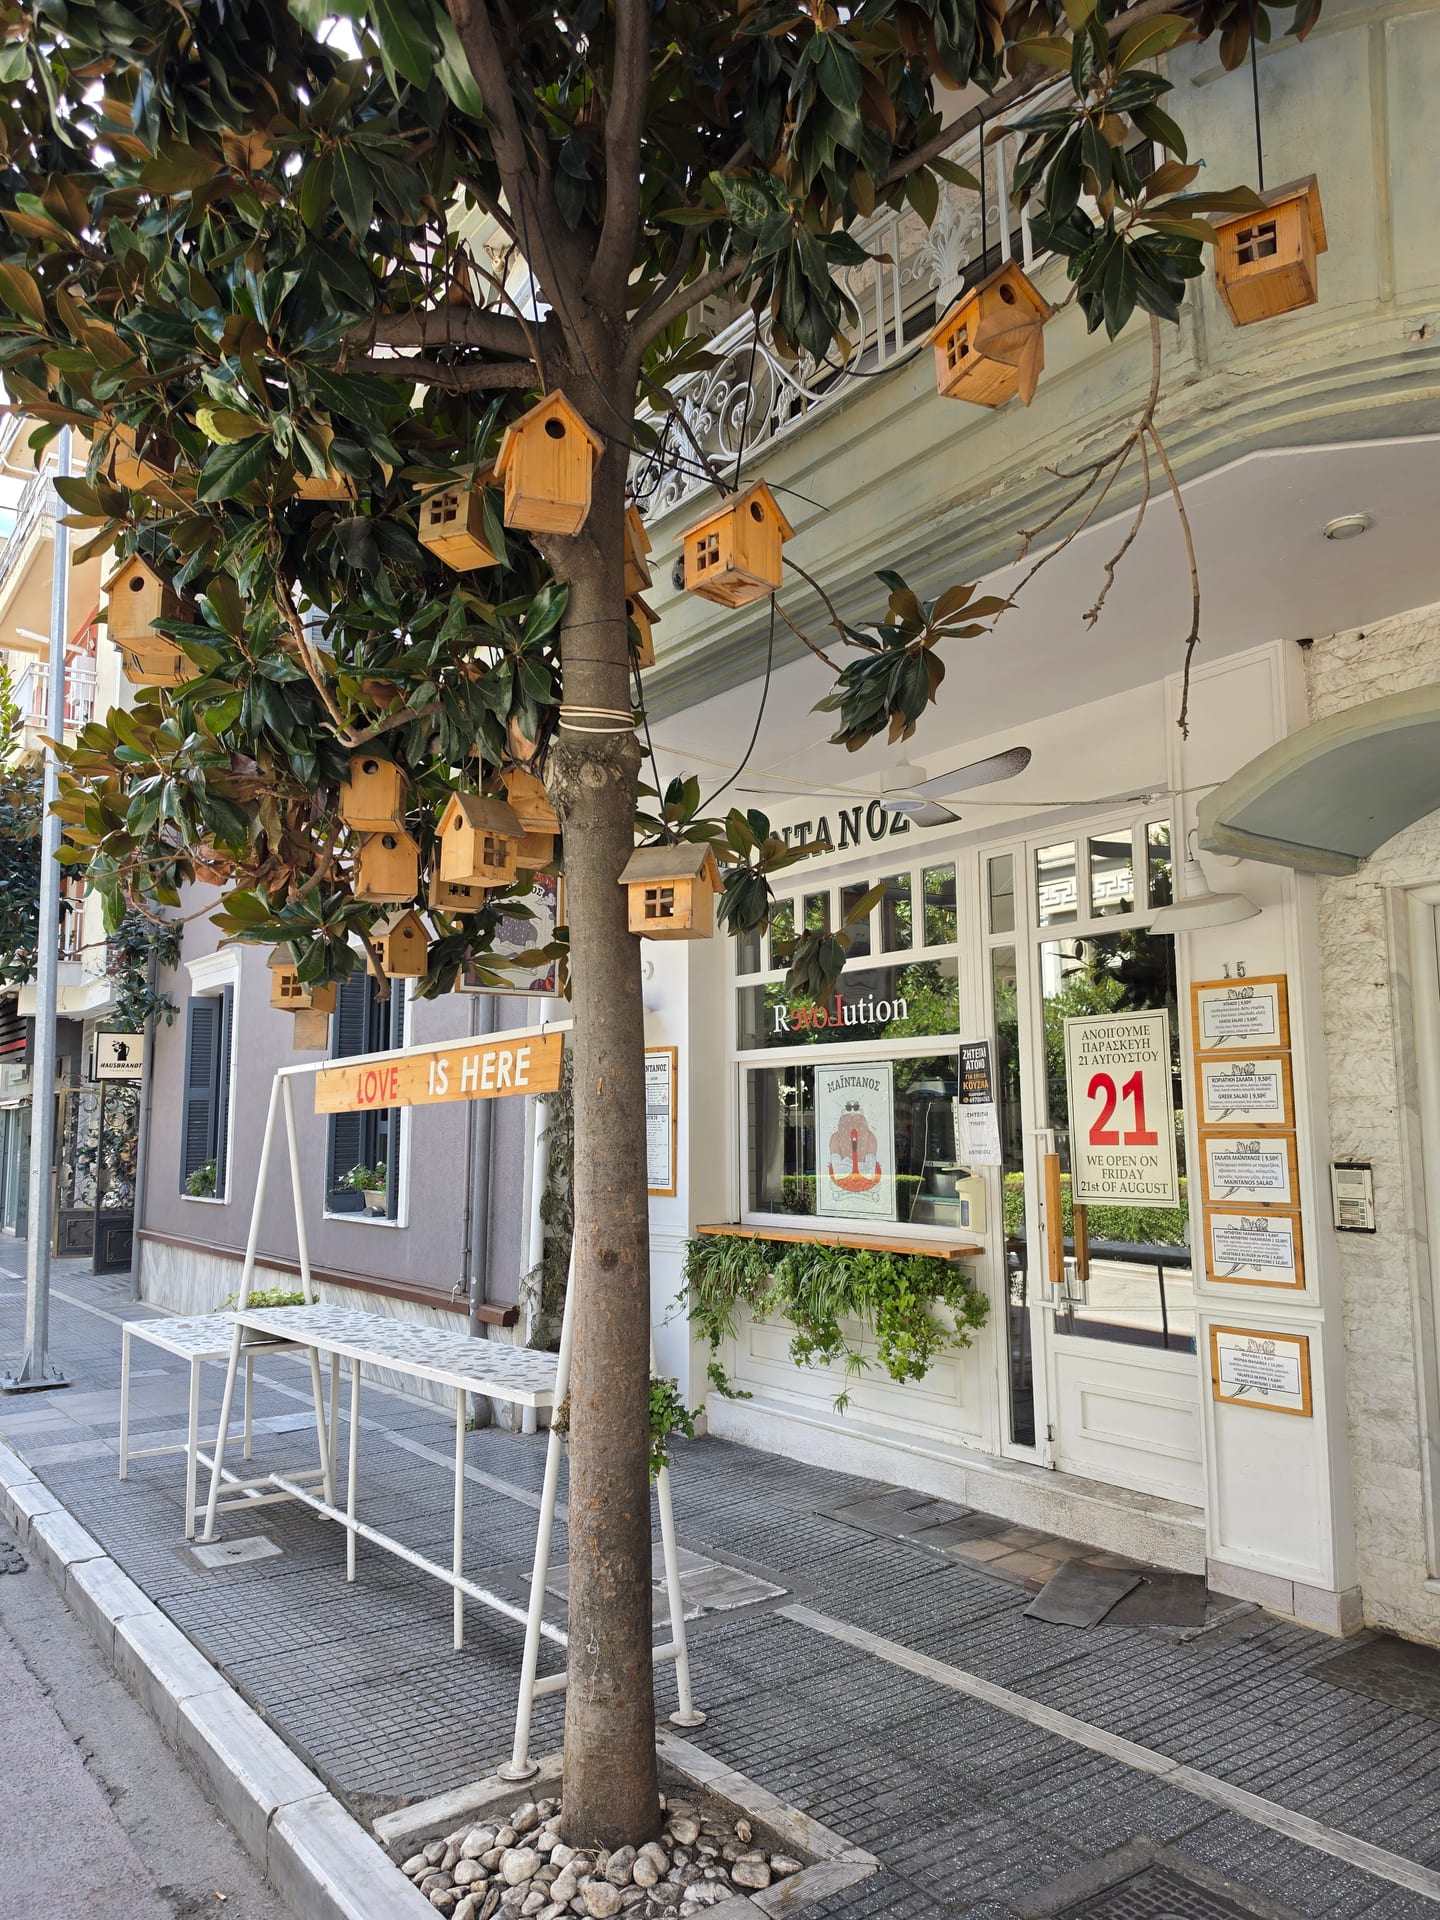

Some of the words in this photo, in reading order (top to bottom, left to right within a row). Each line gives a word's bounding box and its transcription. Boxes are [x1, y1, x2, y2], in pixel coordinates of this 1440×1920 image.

[1081, 1024, 1150, 1040] ΑΝΟΙΓΟΥΜΕ
[1082, 1038, 1151, 1053] ΠΑΡΑΣΚΕΥΗ
[1078, 1055, 1088, 1066] 21
[1091, 1050, 1159, 1065] ΑΥΓΟΥΣΤΟΥ
[357, 1067, 398, 1104] LOVE
[428, 1058, 449, 1096] IS
[460, 1048, 531, 1092] HERE
[826, 1075, 881, 1093] ΜΑΪΝΤΑΝΟΣ
[1087, 1070, 1158, 1146] 21
[1086, 1155, 1104, 1166] WE
[1106, 1155, 1137, 1166] OPEN
[1140, 1156, 1158, 1167] ON
[1102, 1168, 1144, 1180] FRIDAY
[1081, 1181, 1100, 1192] 21st
[1102, 1182, 1116, 1192] OF
[1119, 1182, 1168, 1194] AUGUST
